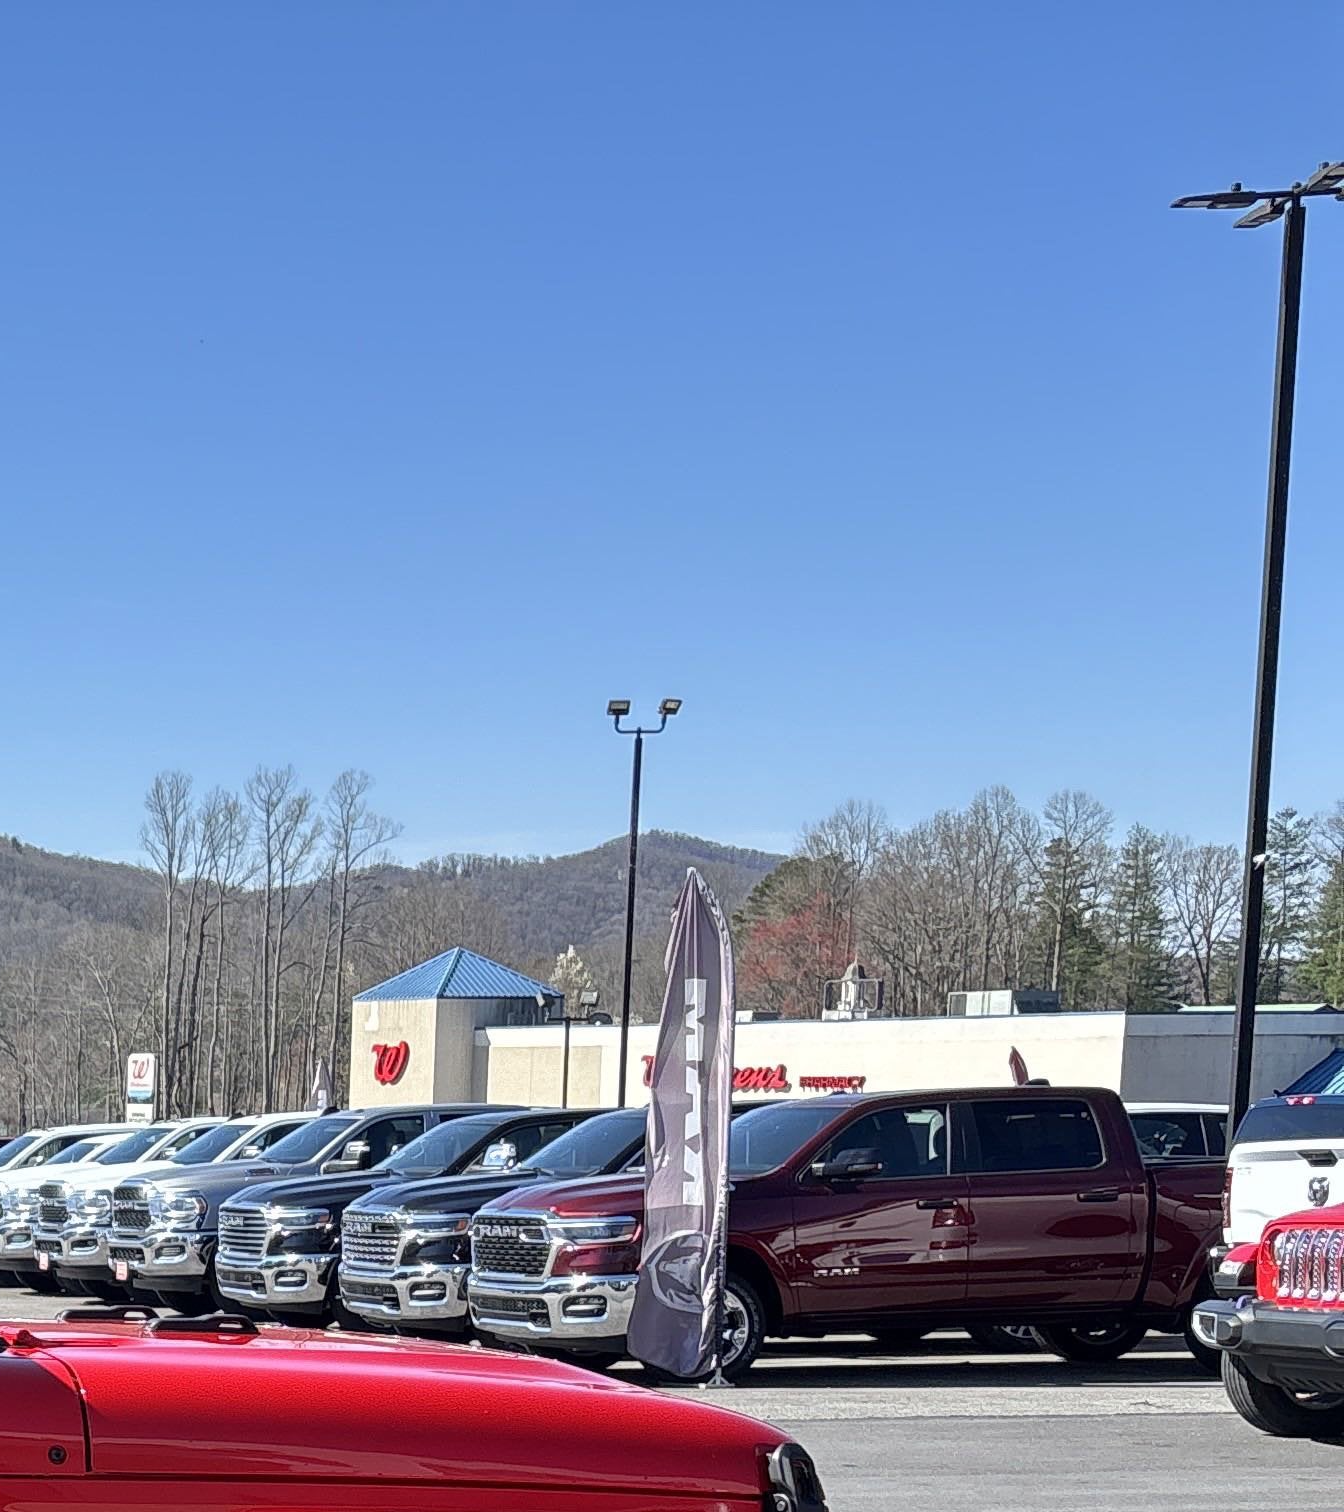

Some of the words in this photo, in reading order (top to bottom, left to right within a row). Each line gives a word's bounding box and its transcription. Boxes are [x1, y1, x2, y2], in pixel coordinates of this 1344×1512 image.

[343, 1222, 373, 1233] RAM
[478, 1225, 519, 1238] RAM
[813, 1267, 860, 1278] RAM
